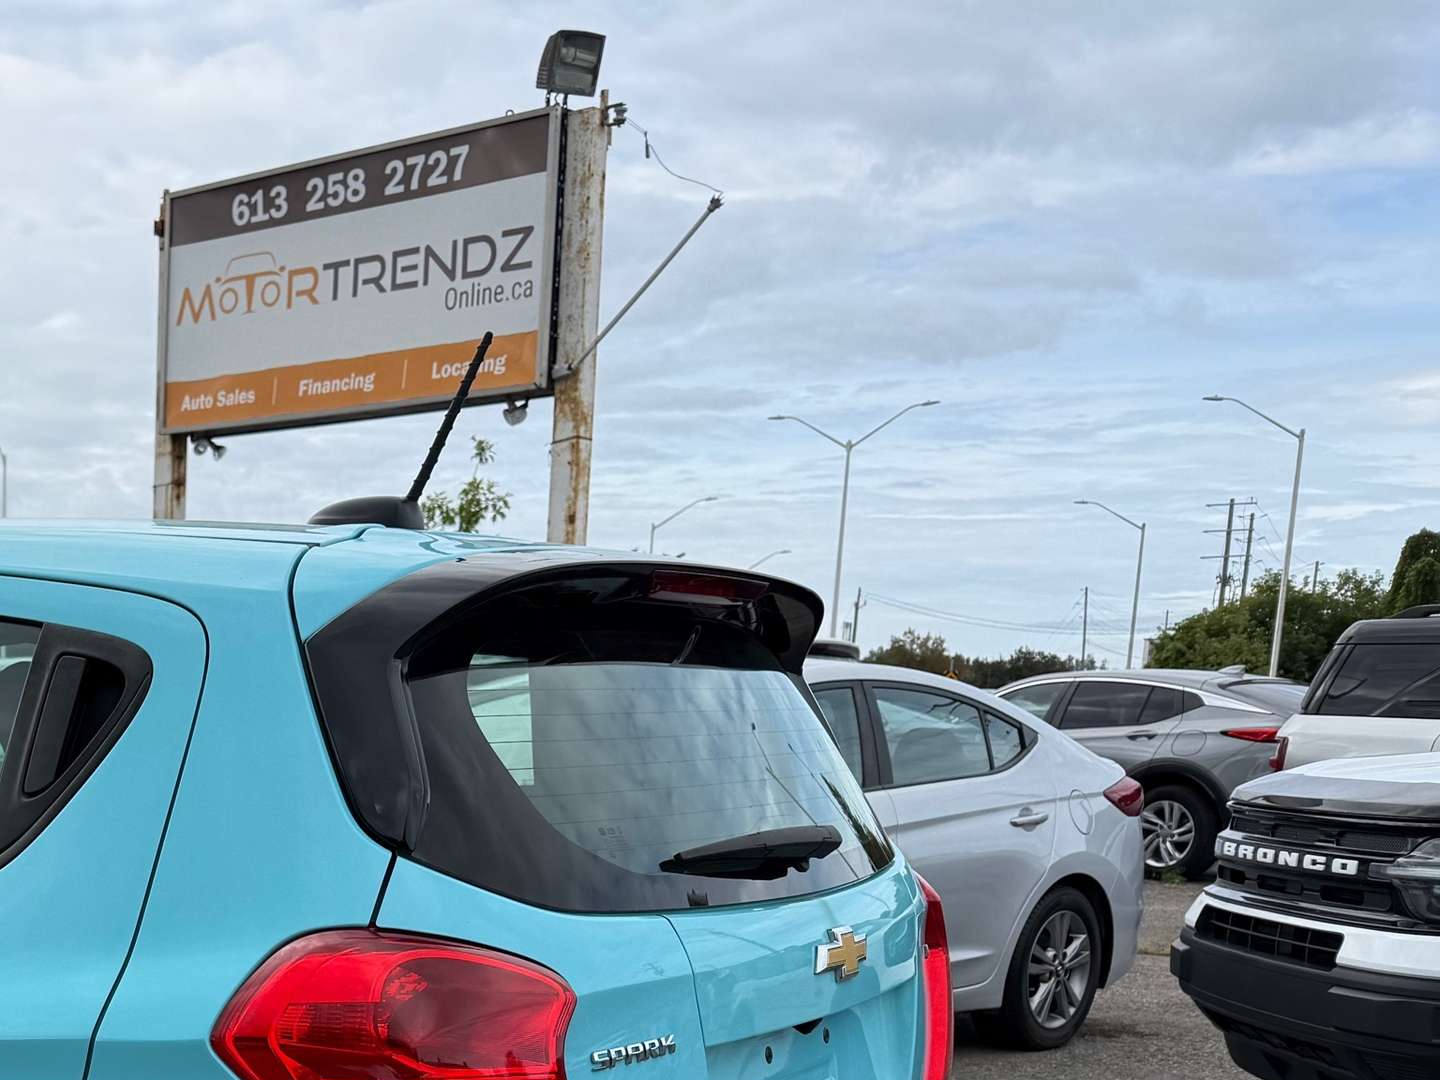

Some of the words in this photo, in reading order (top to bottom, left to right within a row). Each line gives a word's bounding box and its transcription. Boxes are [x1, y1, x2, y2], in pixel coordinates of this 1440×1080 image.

[231, 185, 289, 226] 613
[305, 168, 366, 212] 258
[384, 144, 470, 196] 2727
[444, 279, 534, 311] Online.ca
[181, 393, 214, 413] Auto
[217, 388, 256, 408] Sales
[298, 371, 376, 398] Financing
[1222, 841, 1360, 876] BRONCO
[590, 1033, 677, 1073] SPARK
